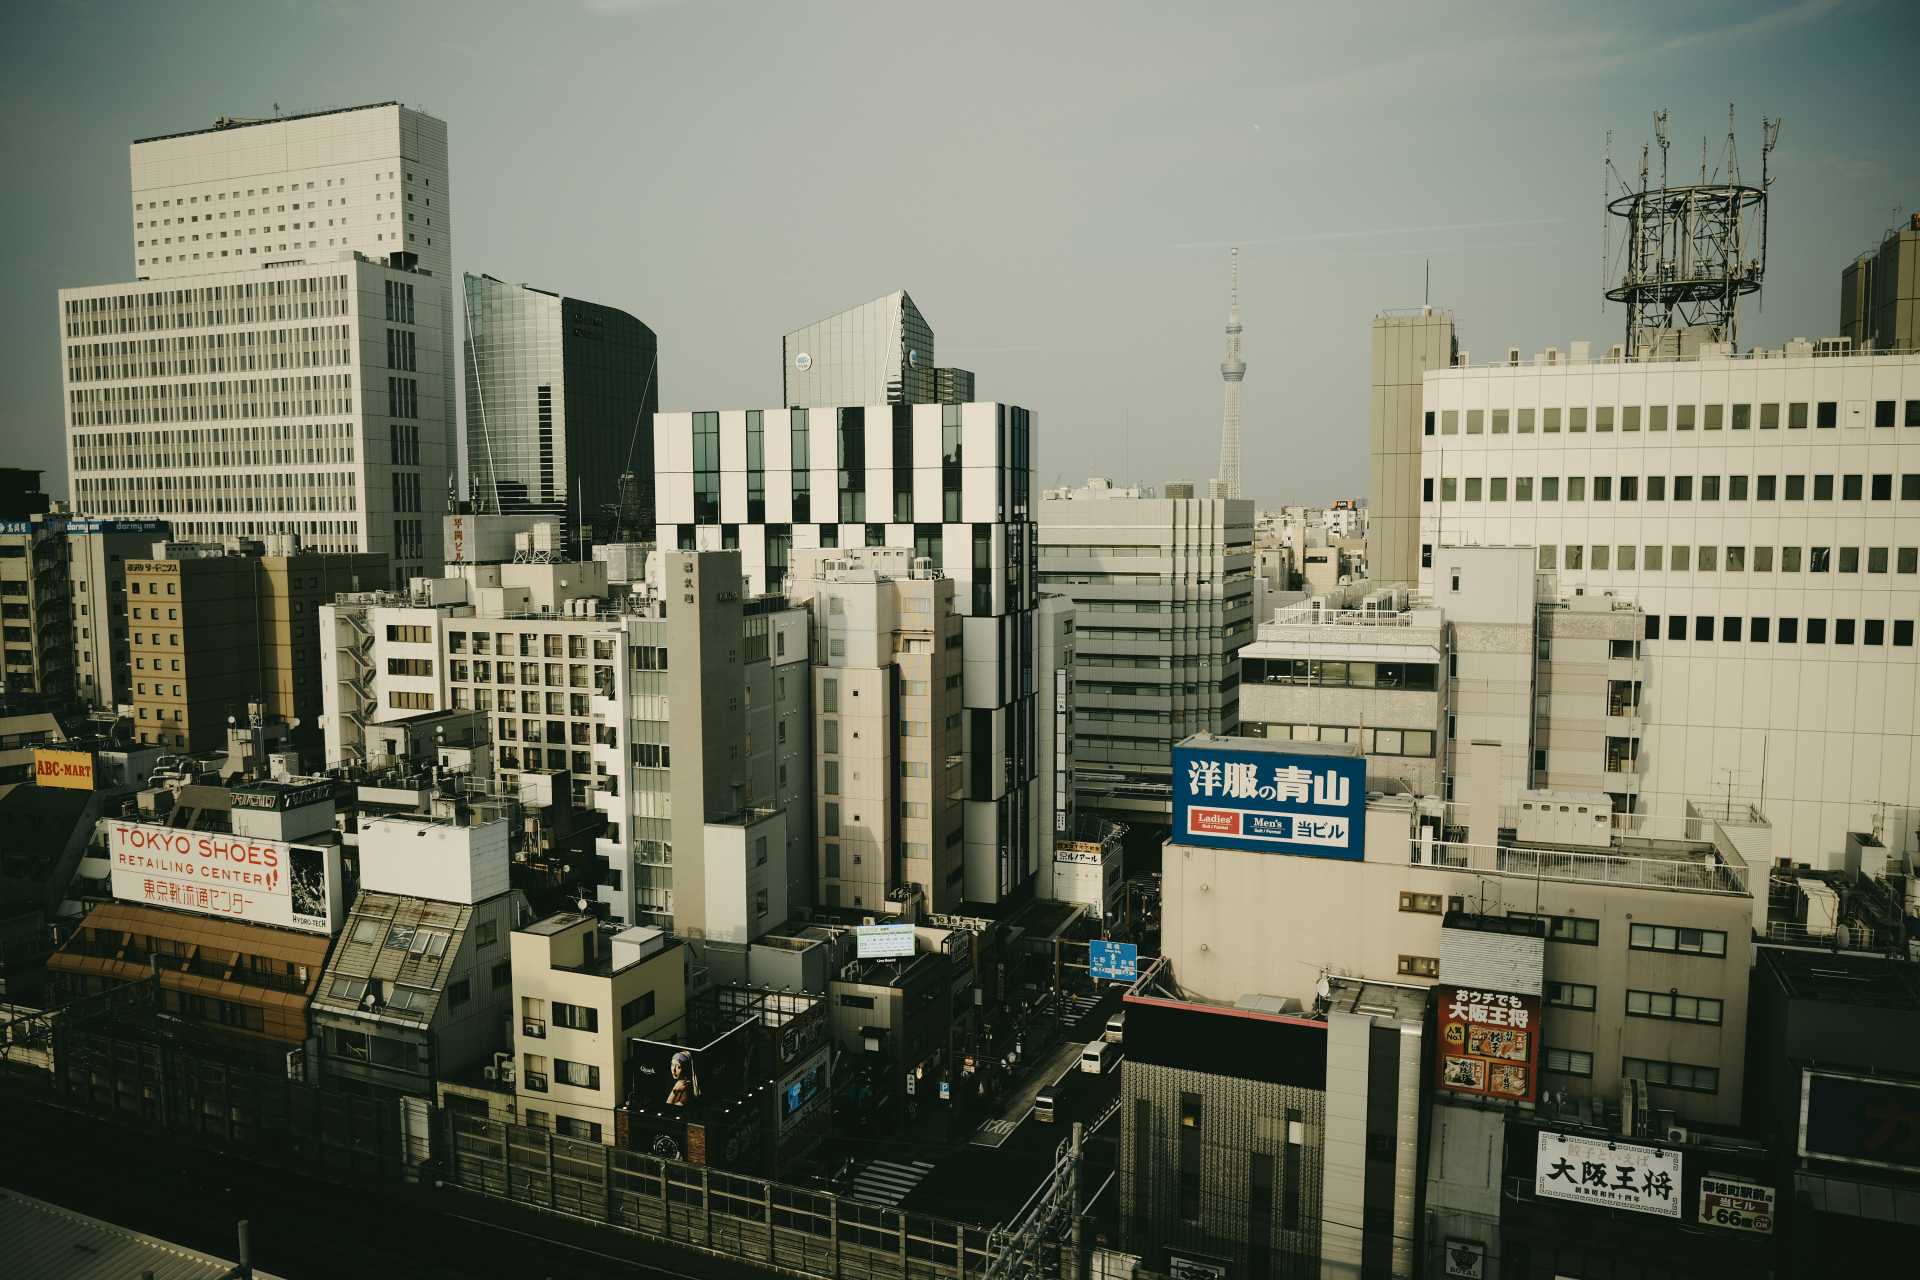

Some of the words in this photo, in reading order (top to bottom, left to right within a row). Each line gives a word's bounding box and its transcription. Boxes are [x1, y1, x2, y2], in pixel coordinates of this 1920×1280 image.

[67, 522, 88, 533] dormy
[90, 523, 99, 531] inn
[116, 522, 143, 532] dormy
[127, 563, 144, 571] ホテル
[37, 760, 91, 777] ABC-MART
[1188, 760, 1350, 807] 洋服の青山
[1198, 813, 1233, 824] Ladies'
[1254, 817, 1283, 829] Men's
[1297, 821, 1345, 840] 当ビル
[116, 828, 191, 854] TOKYO
[198, 839, 278, 867] SHOES
[1068, 852, 1097, 862] ルノアール
[119, 854, 194, 875] RETAILING
[201, 866, 263, 886] CENTER
[143, 878, 254, 914] 東京靴流通センター
[292, 914, 326, 928] HYDRO-TECH
[1456, 989, 1522, 1009] おウチでも
[1449, 1002, 1528, 1028] 大阪王将
[1447, 1026, 1462, 1034] 人気
[781, 1027, 799, 1063] 質
[1567, 1143, 1650, 1168] 餃子といえば
[1545, 1156, 1674, 1201] 大阪王将
[1575, 1186, 1640, 1203] 創業昭和四十四年
[1702, 1180, 1773, 1202] 御徒町駅前店
[1720, 1197, 1756, 1211] 当ビル
[1755, 1222, 1769, 1230] OK
[1450, 1266, 1478, 1277] ROYAL
